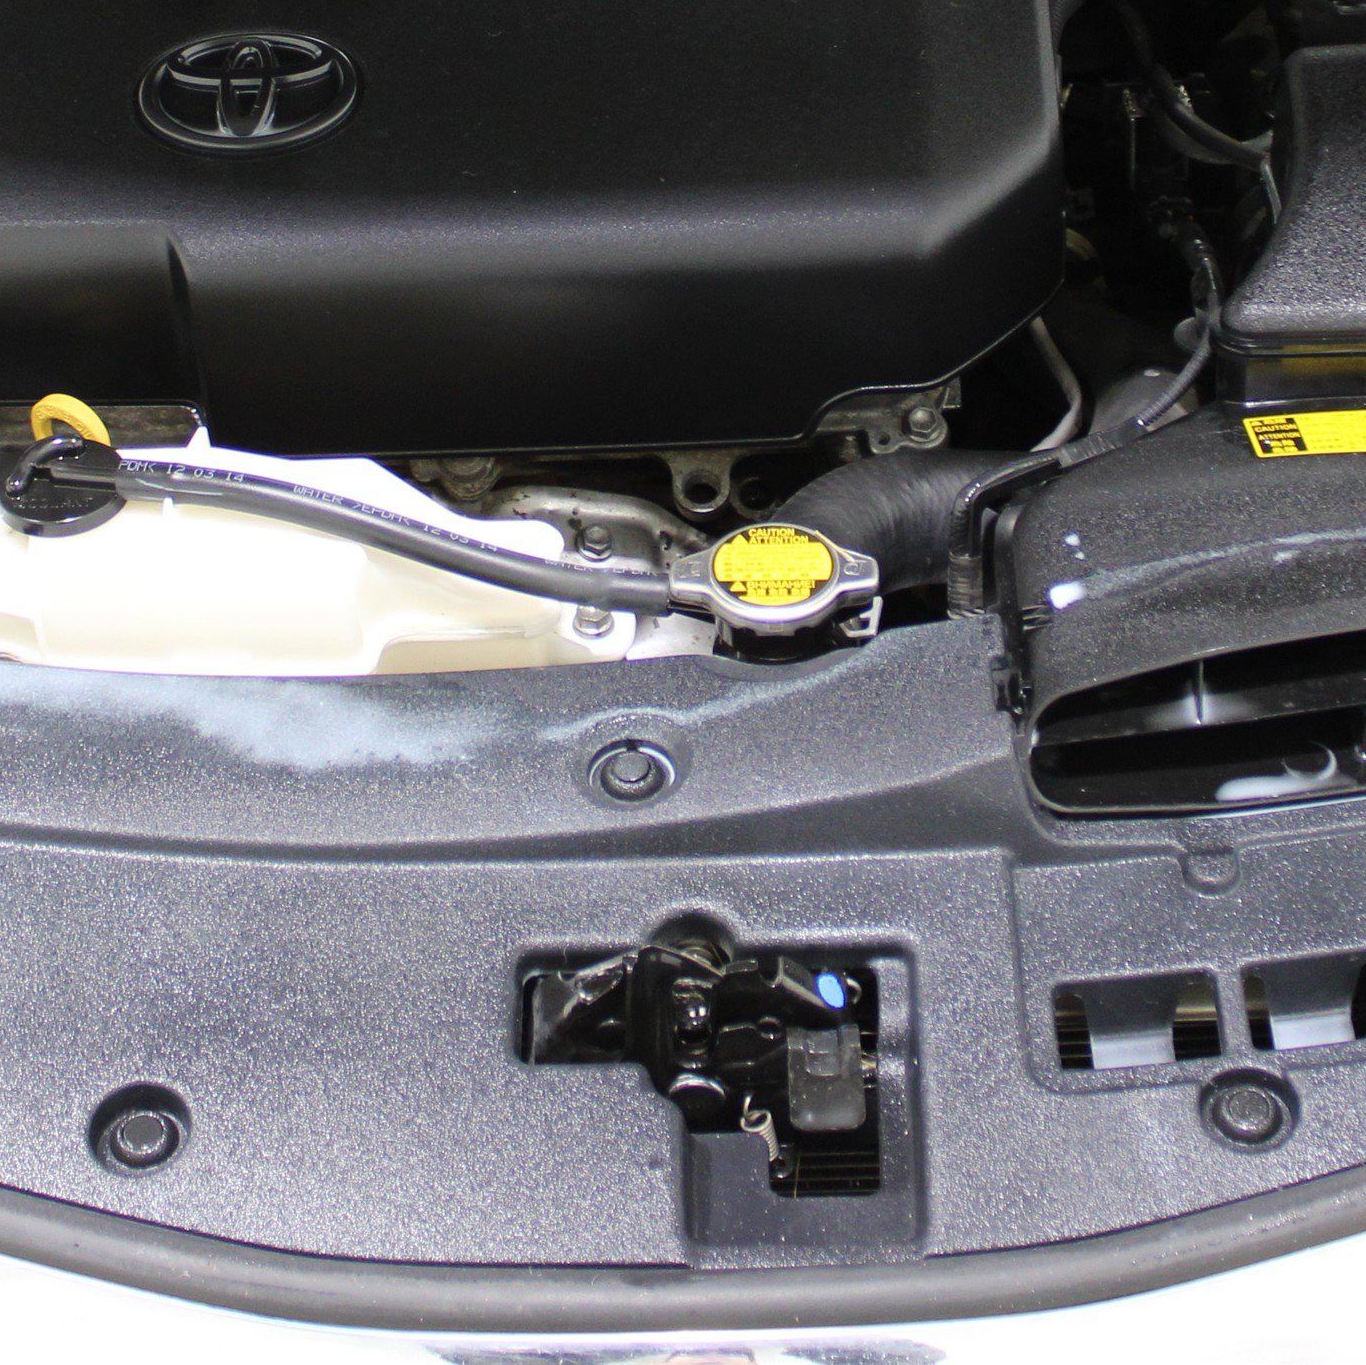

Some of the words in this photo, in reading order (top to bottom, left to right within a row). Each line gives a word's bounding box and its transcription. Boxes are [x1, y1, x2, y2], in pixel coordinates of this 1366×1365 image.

[1254, 423, 1297, 433] CAUTION
[1258, 432, 1301, 440] ATTENTION
[166, 463, 186, 476] 12
[193, 468, 215, 480] 03
[225, 471, 244, 483] 14
[293, 485, 343, 505] WATER
[748, 528, 795, 537] CAUTION
[749, 536, 809, 544] ATTENTION
